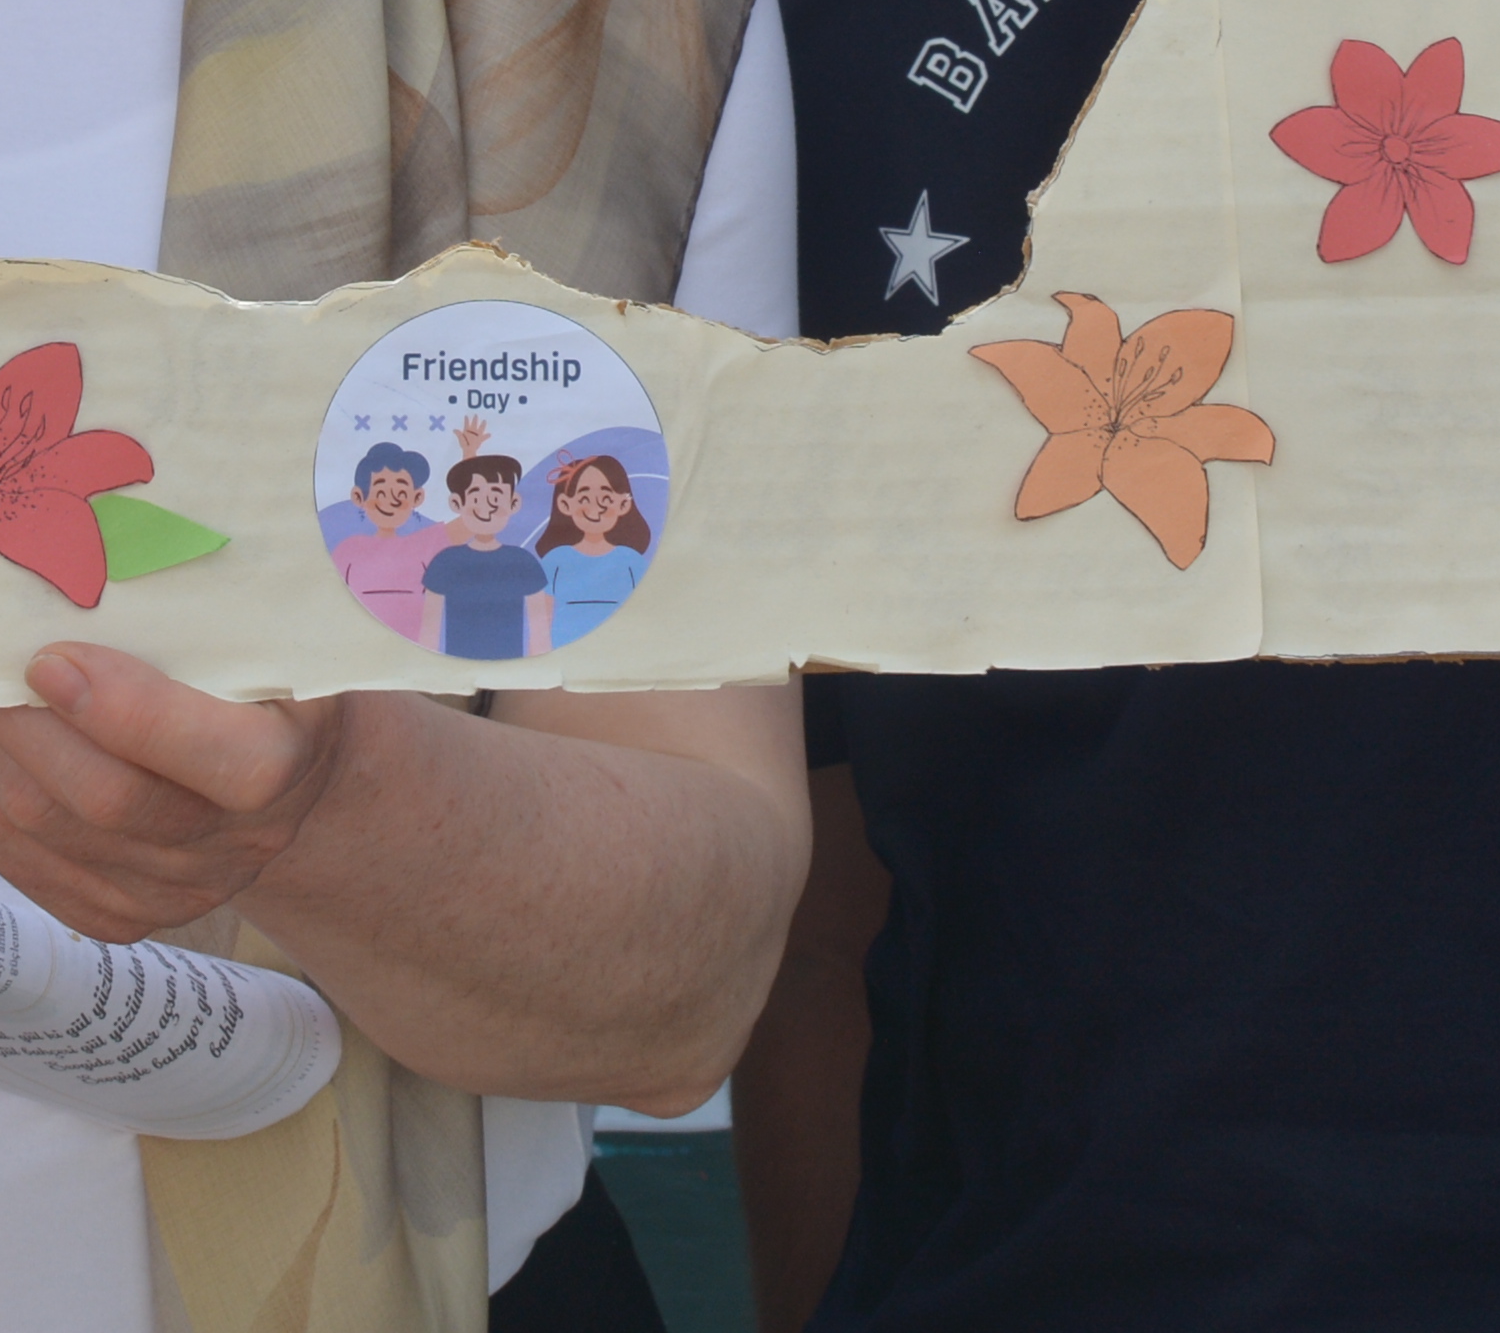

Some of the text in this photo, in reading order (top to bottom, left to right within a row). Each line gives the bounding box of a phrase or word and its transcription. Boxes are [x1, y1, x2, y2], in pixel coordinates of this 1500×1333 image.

[402, 351, 581, 388] Friendship
[467, 389, 510, 414] Day
[66, 1011, 92, 1037] gül
[81, 1036, 107, 1052] gül
[116, 1029, 161, 1062] güller
